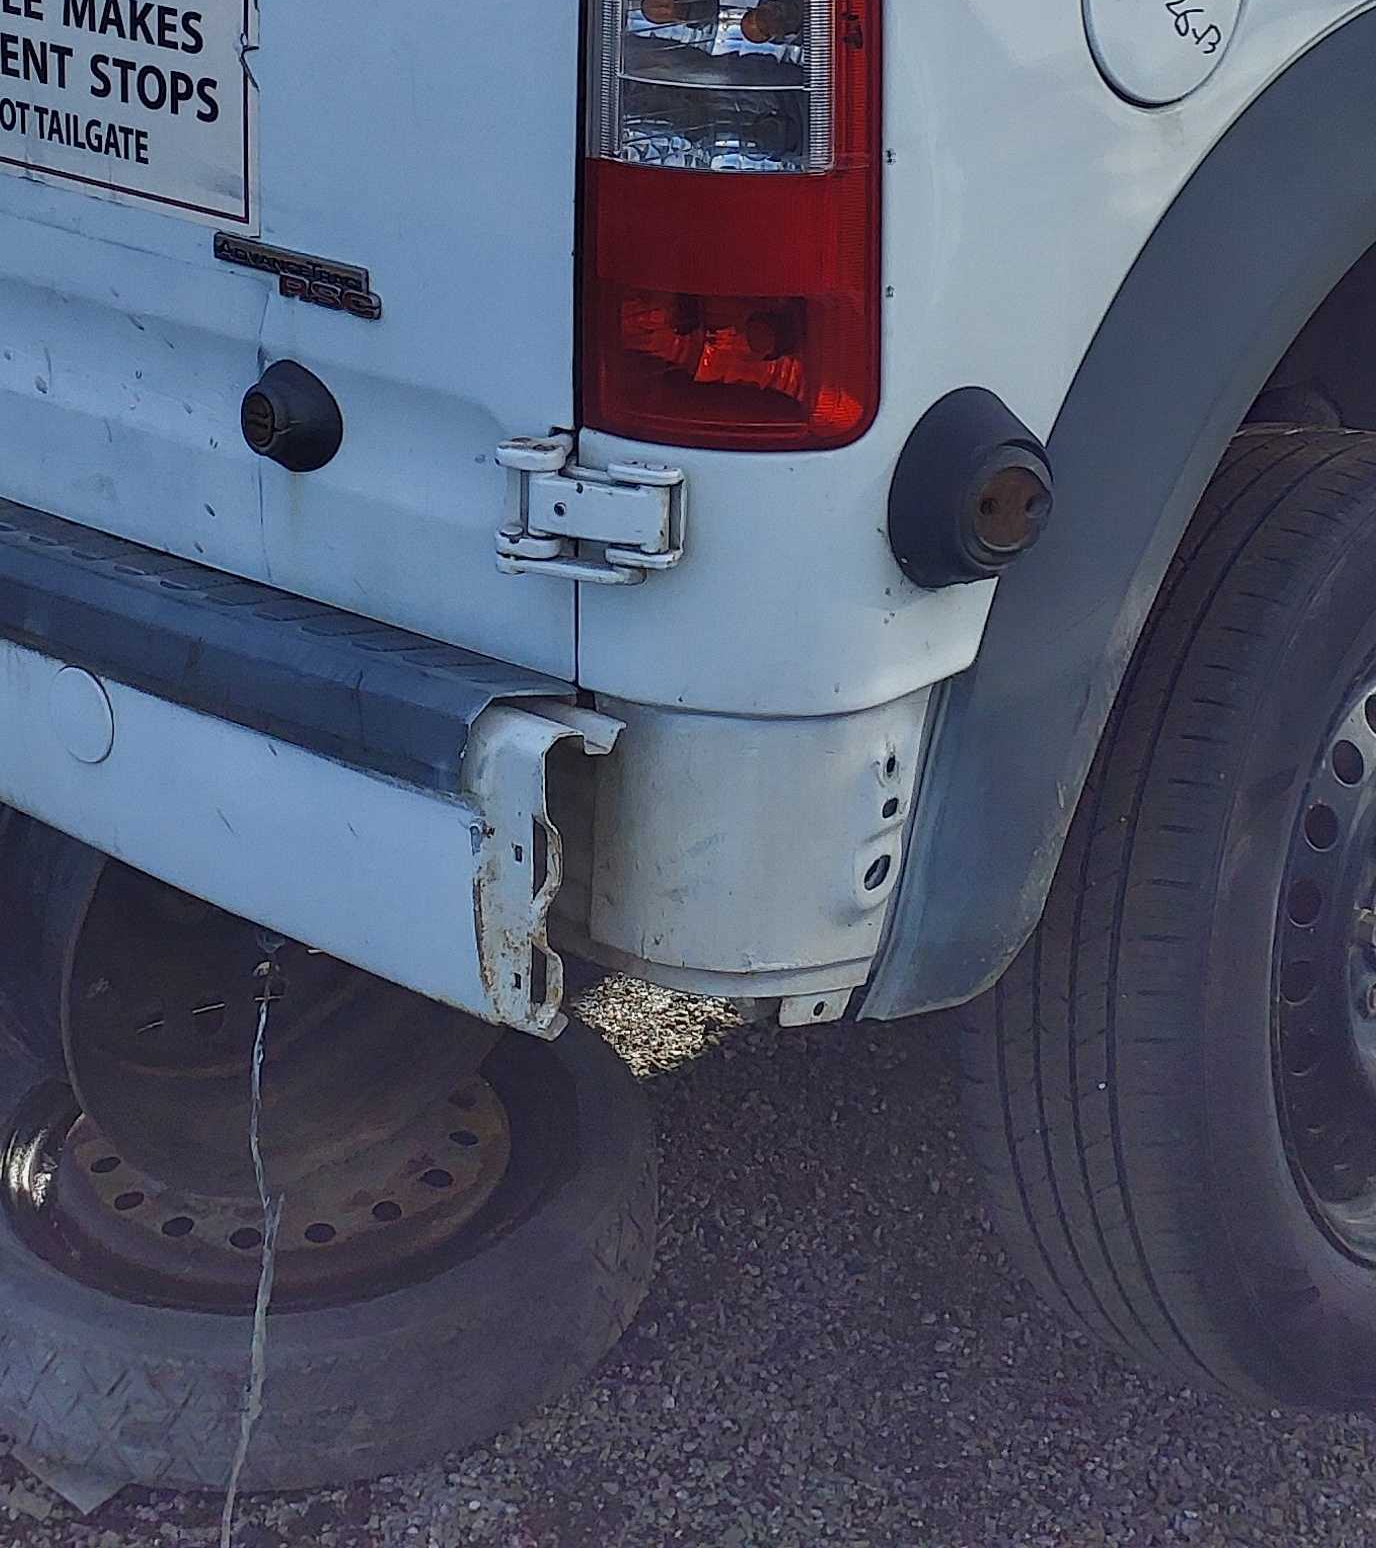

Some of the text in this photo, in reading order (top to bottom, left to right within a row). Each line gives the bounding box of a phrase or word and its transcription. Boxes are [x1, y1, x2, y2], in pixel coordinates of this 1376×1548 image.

[89, 53, 220, 124] STOPS
[32, 107, 150, 165] TAILGATE
[278, 272, 382, 321] RSC
